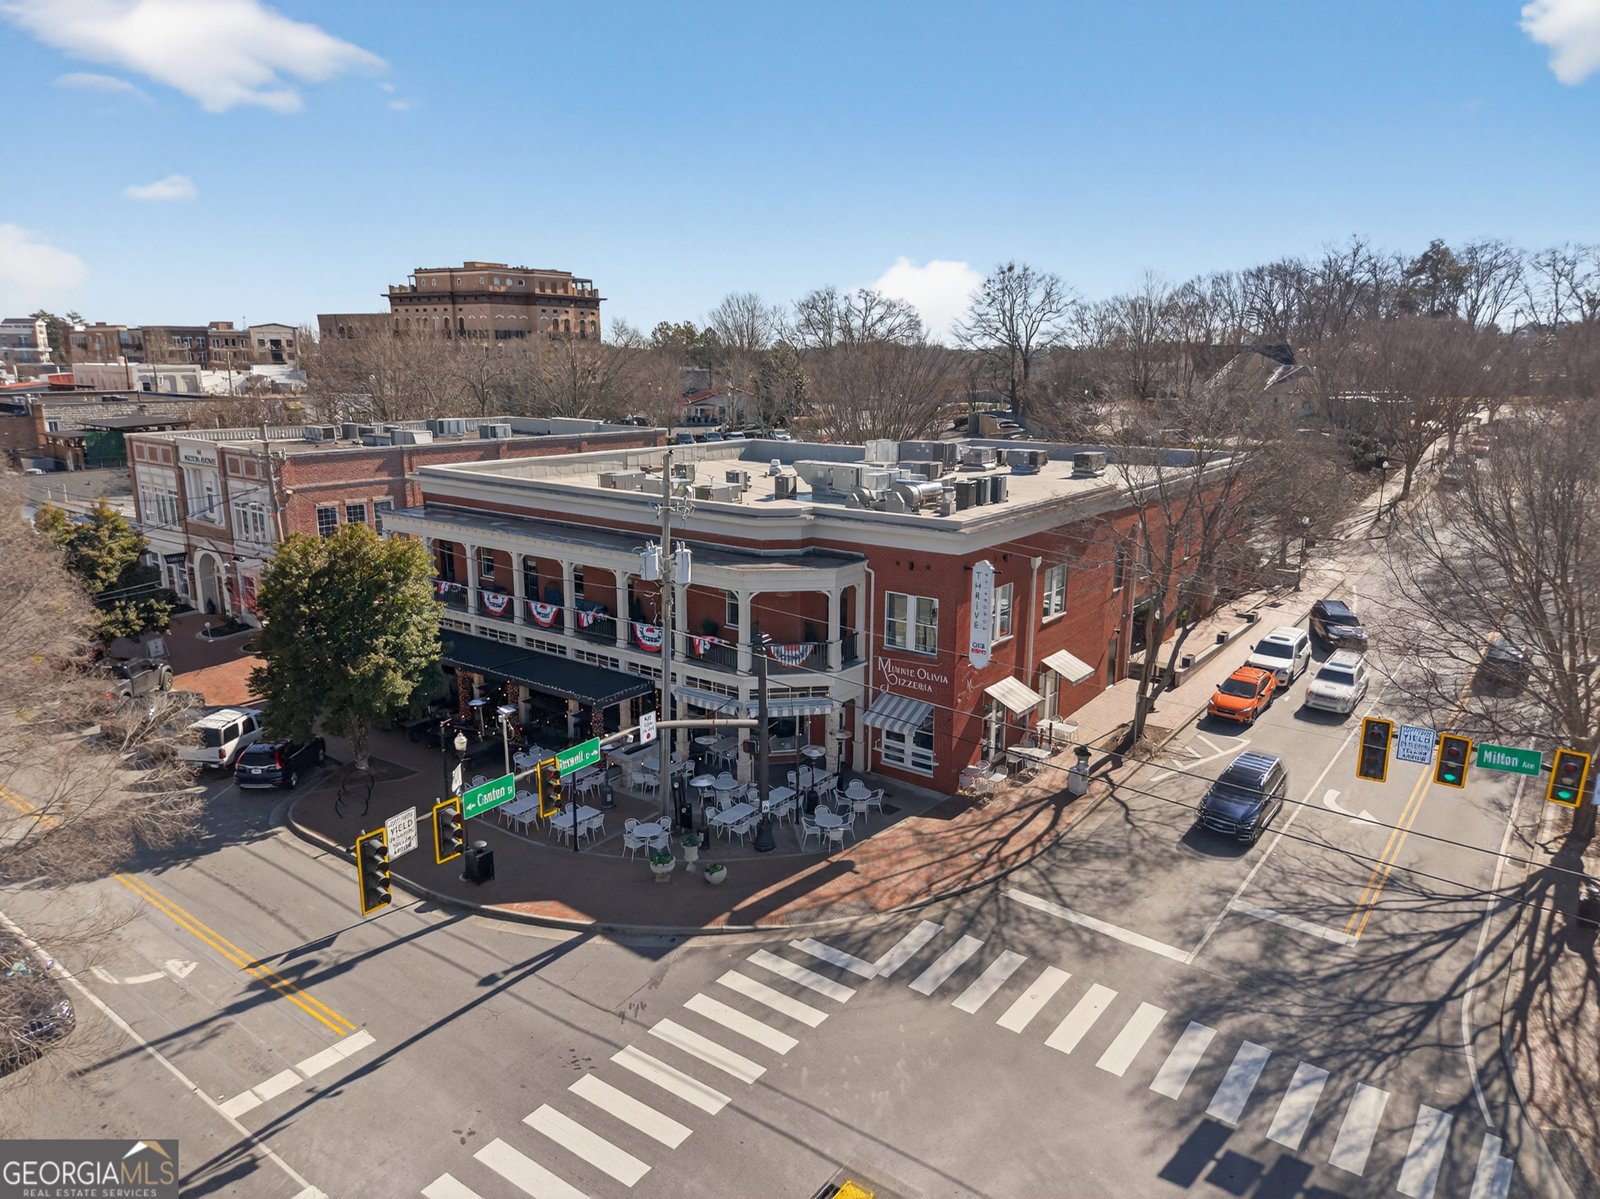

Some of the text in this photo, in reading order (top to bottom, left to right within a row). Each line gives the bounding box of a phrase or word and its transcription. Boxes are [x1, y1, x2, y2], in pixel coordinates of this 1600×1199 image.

[878, 656, 948, 684] MINNIE OLIVIA
[880, 673, 932, 693] PIZZERIA
[1404, 734, 1430, 744] YIELD
[1483, 750, 1519, 767] Milton
[477, 787, 505, 807] Canton
[390, 820, 413, 834] YIELD
